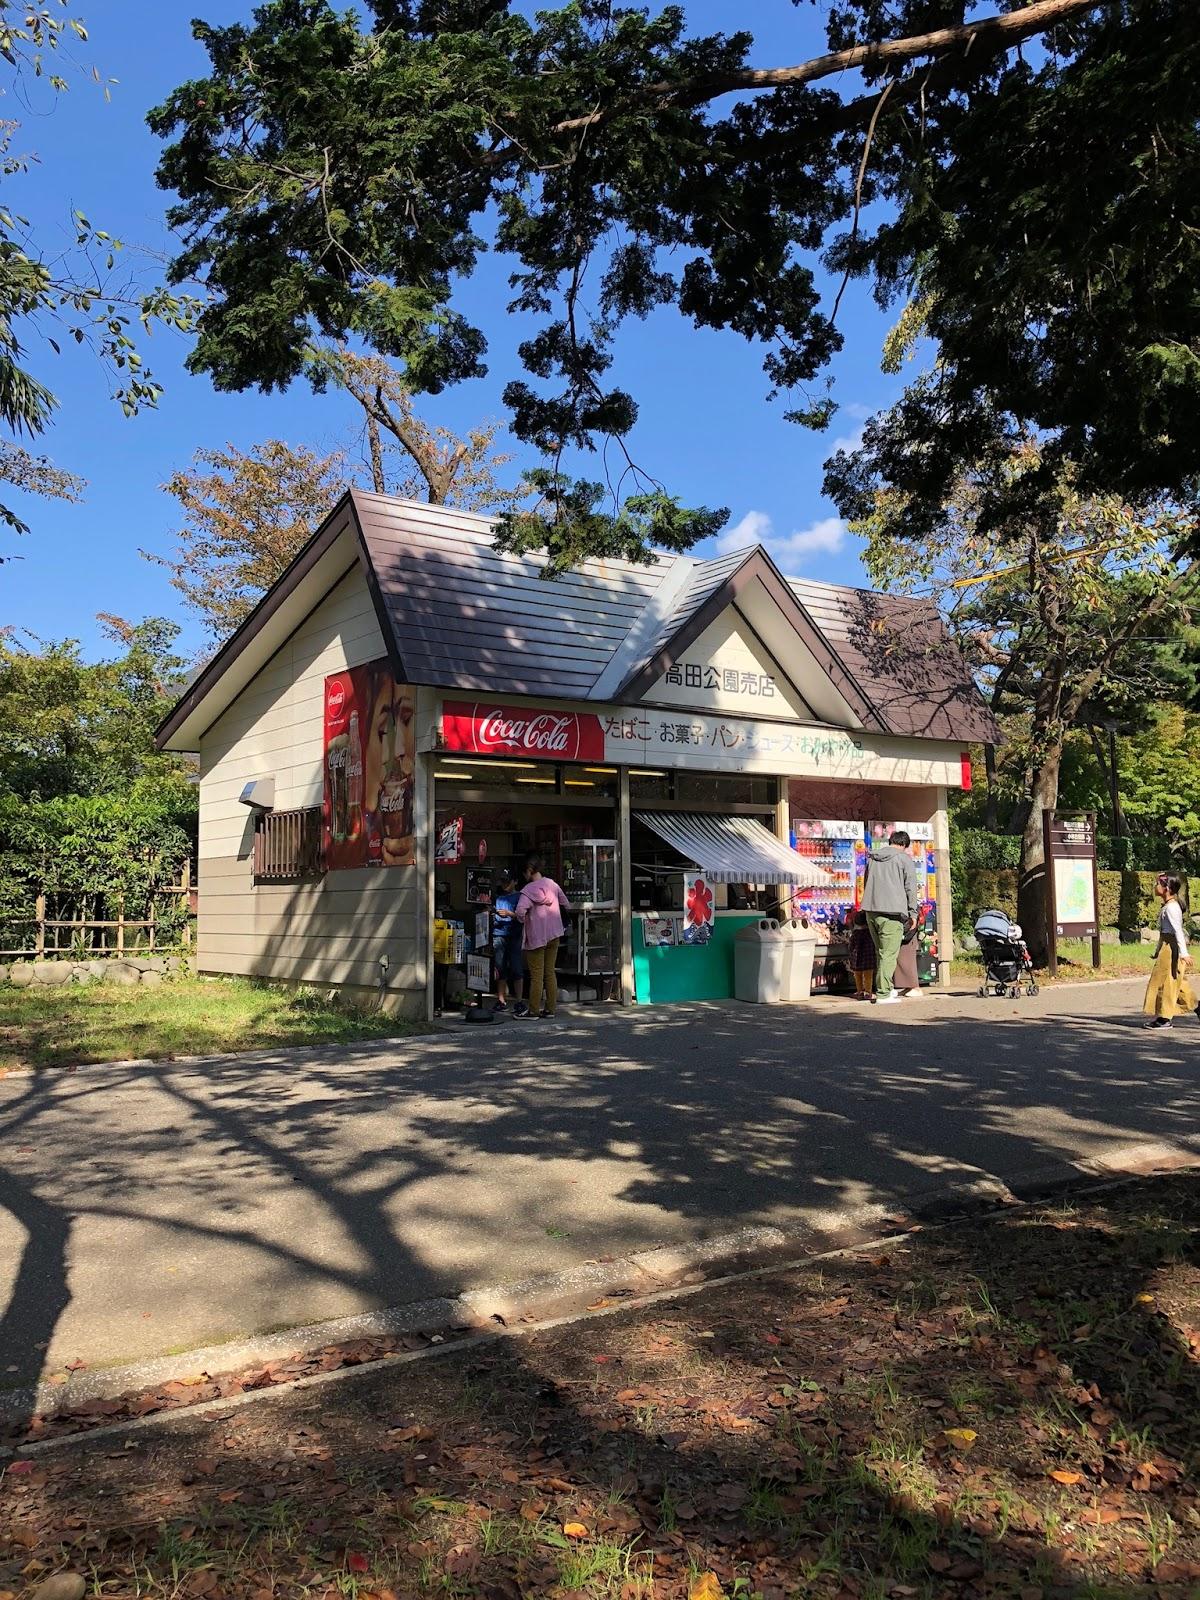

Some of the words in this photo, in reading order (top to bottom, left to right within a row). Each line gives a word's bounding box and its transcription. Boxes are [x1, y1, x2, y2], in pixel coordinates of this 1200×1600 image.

[665, 662, 775, 697] 高田公園売店
[479, 710, 574, 751] Coca-Cola
